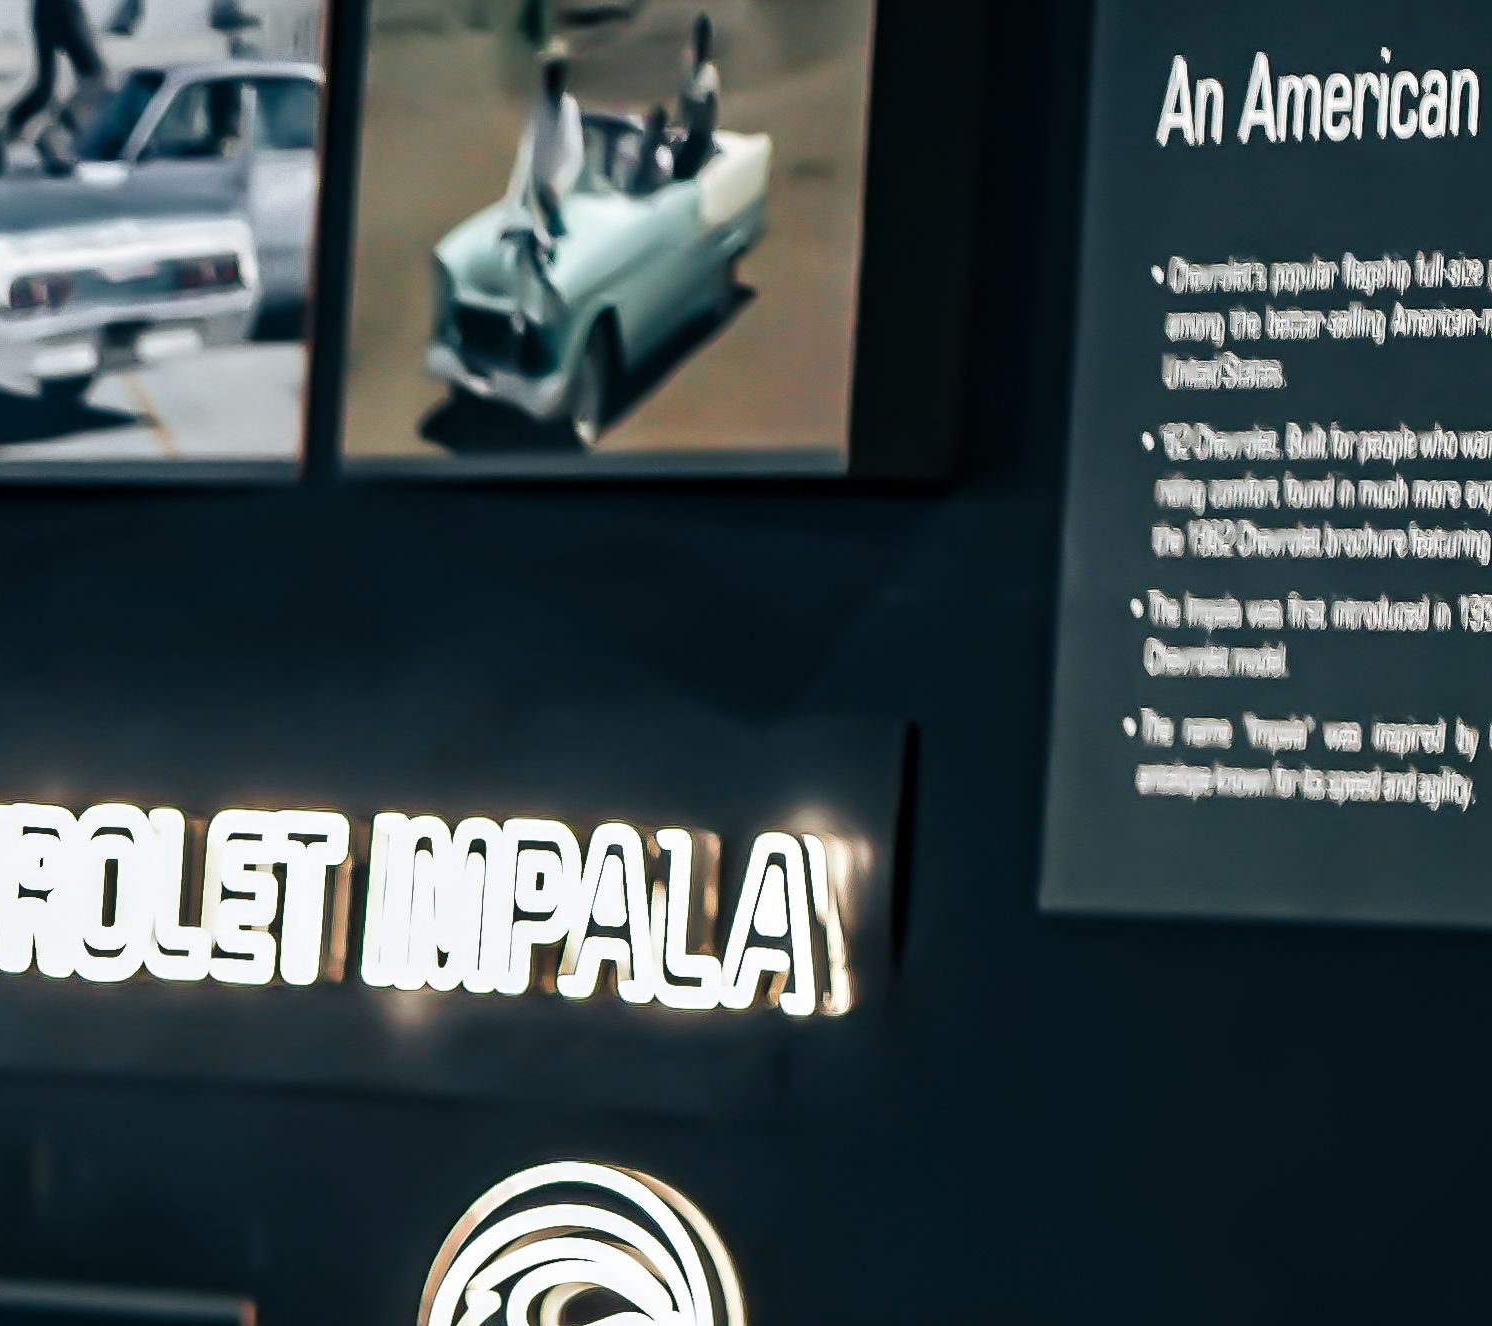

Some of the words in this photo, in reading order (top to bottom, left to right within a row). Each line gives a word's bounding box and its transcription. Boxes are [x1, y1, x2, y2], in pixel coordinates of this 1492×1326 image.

[1155, 54, 1224, 148] An
[1236, 45, 1480, 146] American
[360, 811, 852, 1017] IMPALA
